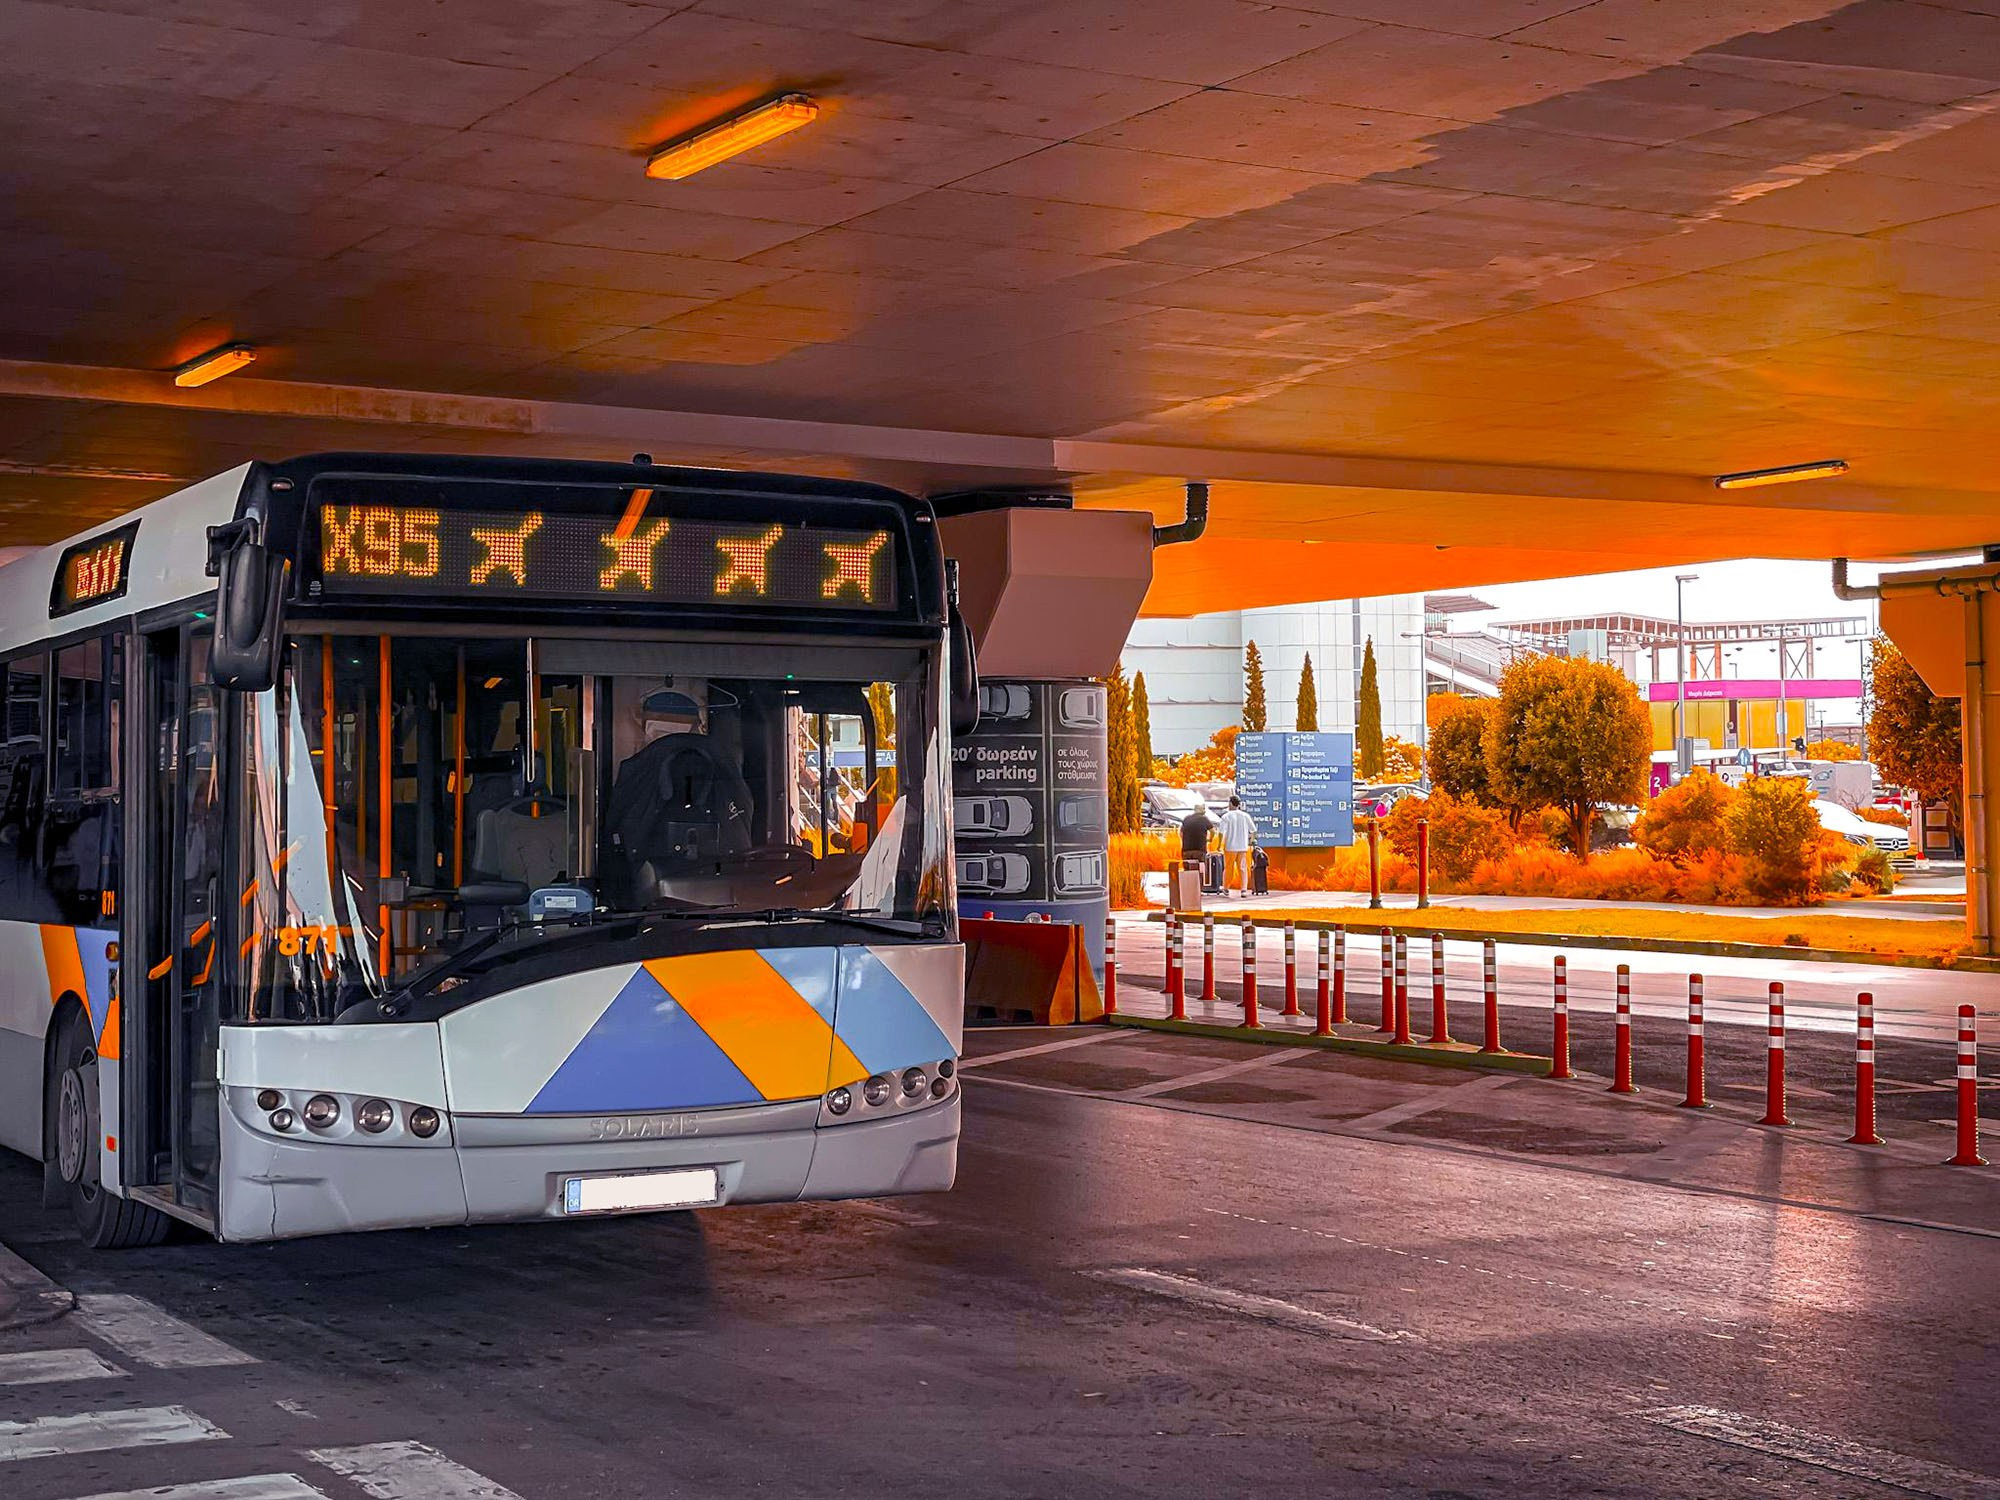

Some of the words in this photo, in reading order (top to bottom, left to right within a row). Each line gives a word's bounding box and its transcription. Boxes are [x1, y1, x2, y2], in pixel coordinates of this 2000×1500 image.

[324, 504, 440, 577] X95
[976, 745, 1037, 764] δωρεάν
[1057, 749, 1068, 757] σε
[1069, 746, 1089, 758] όλους
[1057, 760, 1076, 769] τους
[1077, 758, 1098, 770] χώρους
[976, 765, 1037, 783] parking
[1057, 769, 1097, 782] στάθμευσης
[1653, 776, 1661, 788] 2
[102, 890, 115, 915] 871
[279, 925, 337, 956] 871
[590, 1115, 699, 1140] SOLARIS
